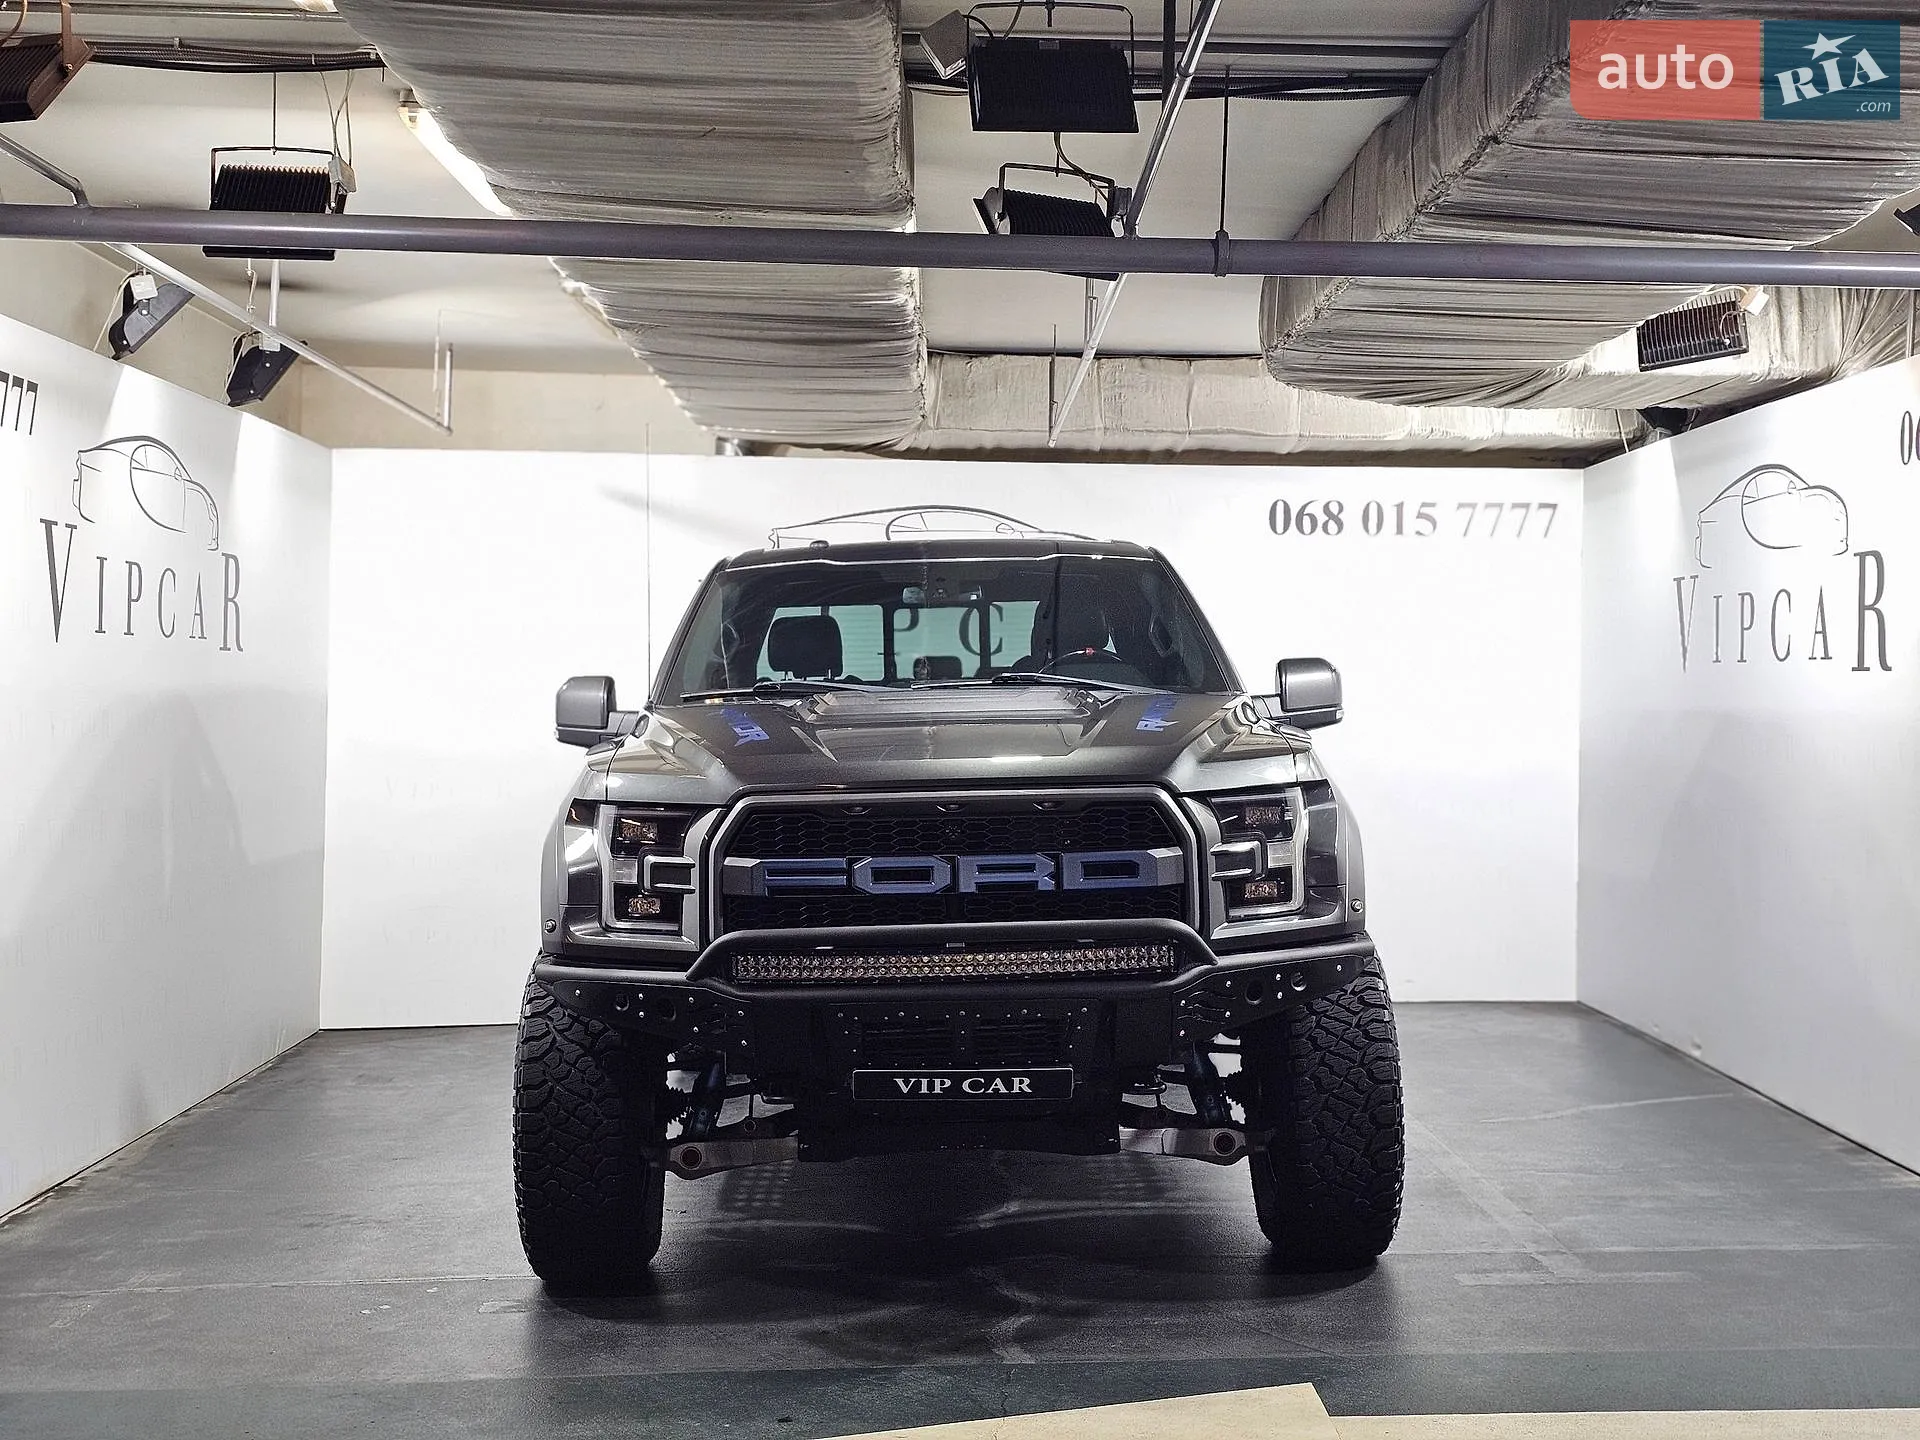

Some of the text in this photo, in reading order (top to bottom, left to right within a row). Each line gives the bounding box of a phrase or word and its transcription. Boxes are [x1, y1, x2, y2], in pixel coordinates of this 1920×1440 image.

[1268, 498, 1559, 538] 068 015 7777
[762, 850, 1159, 897] FORD
[893, 1077, 1033, 1094] VIP CAR
